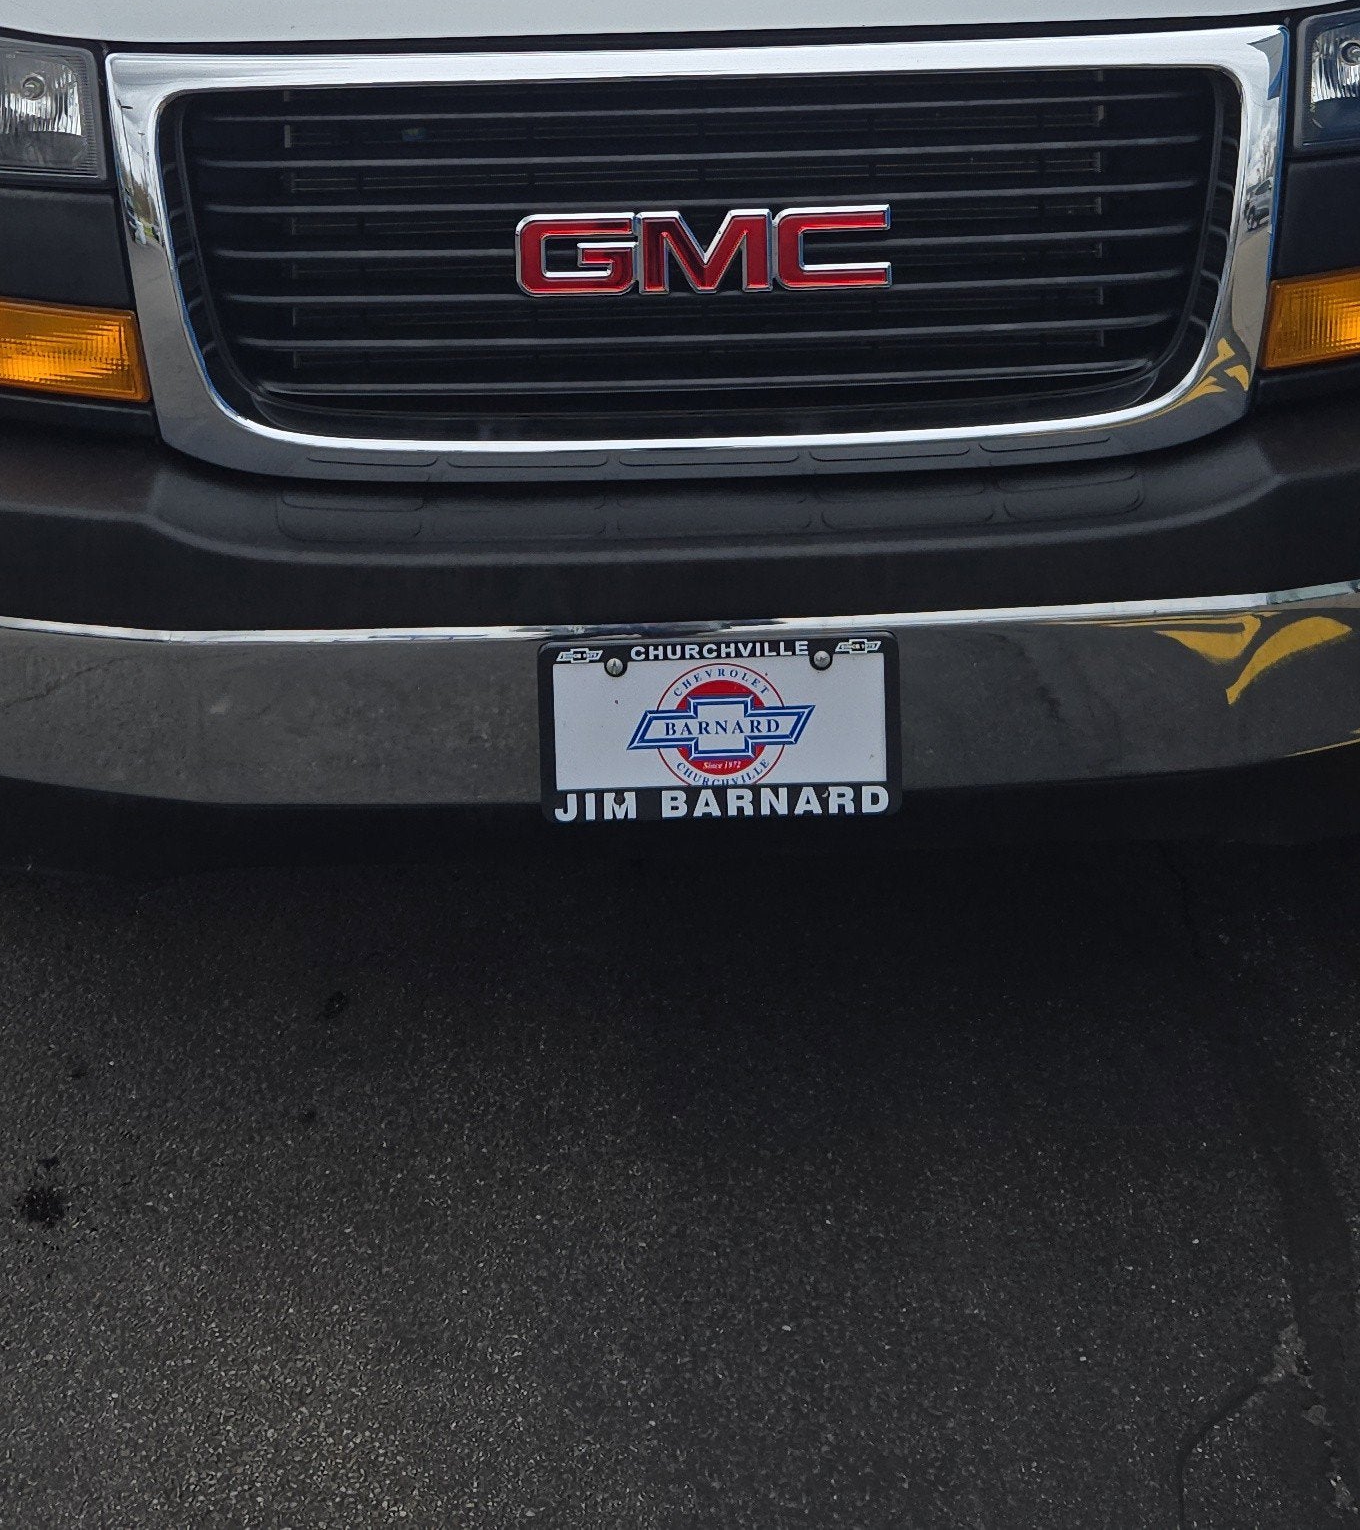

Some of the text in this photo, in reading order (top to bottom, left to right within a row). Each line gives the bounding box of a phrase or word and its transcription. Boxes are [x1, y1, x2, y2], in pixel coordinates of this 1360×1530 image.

[515, 203, 892, 297] GMC
[630, 640, 809, 661] CHURCHVILLE
[673, 668, 769, 697] CHEVROLET
[664, 718, 780, 736] BARNARD
[676, 758, 770, 786] CHURCHVILLE
[554, 785, 890, 821] JIM BARNARD
